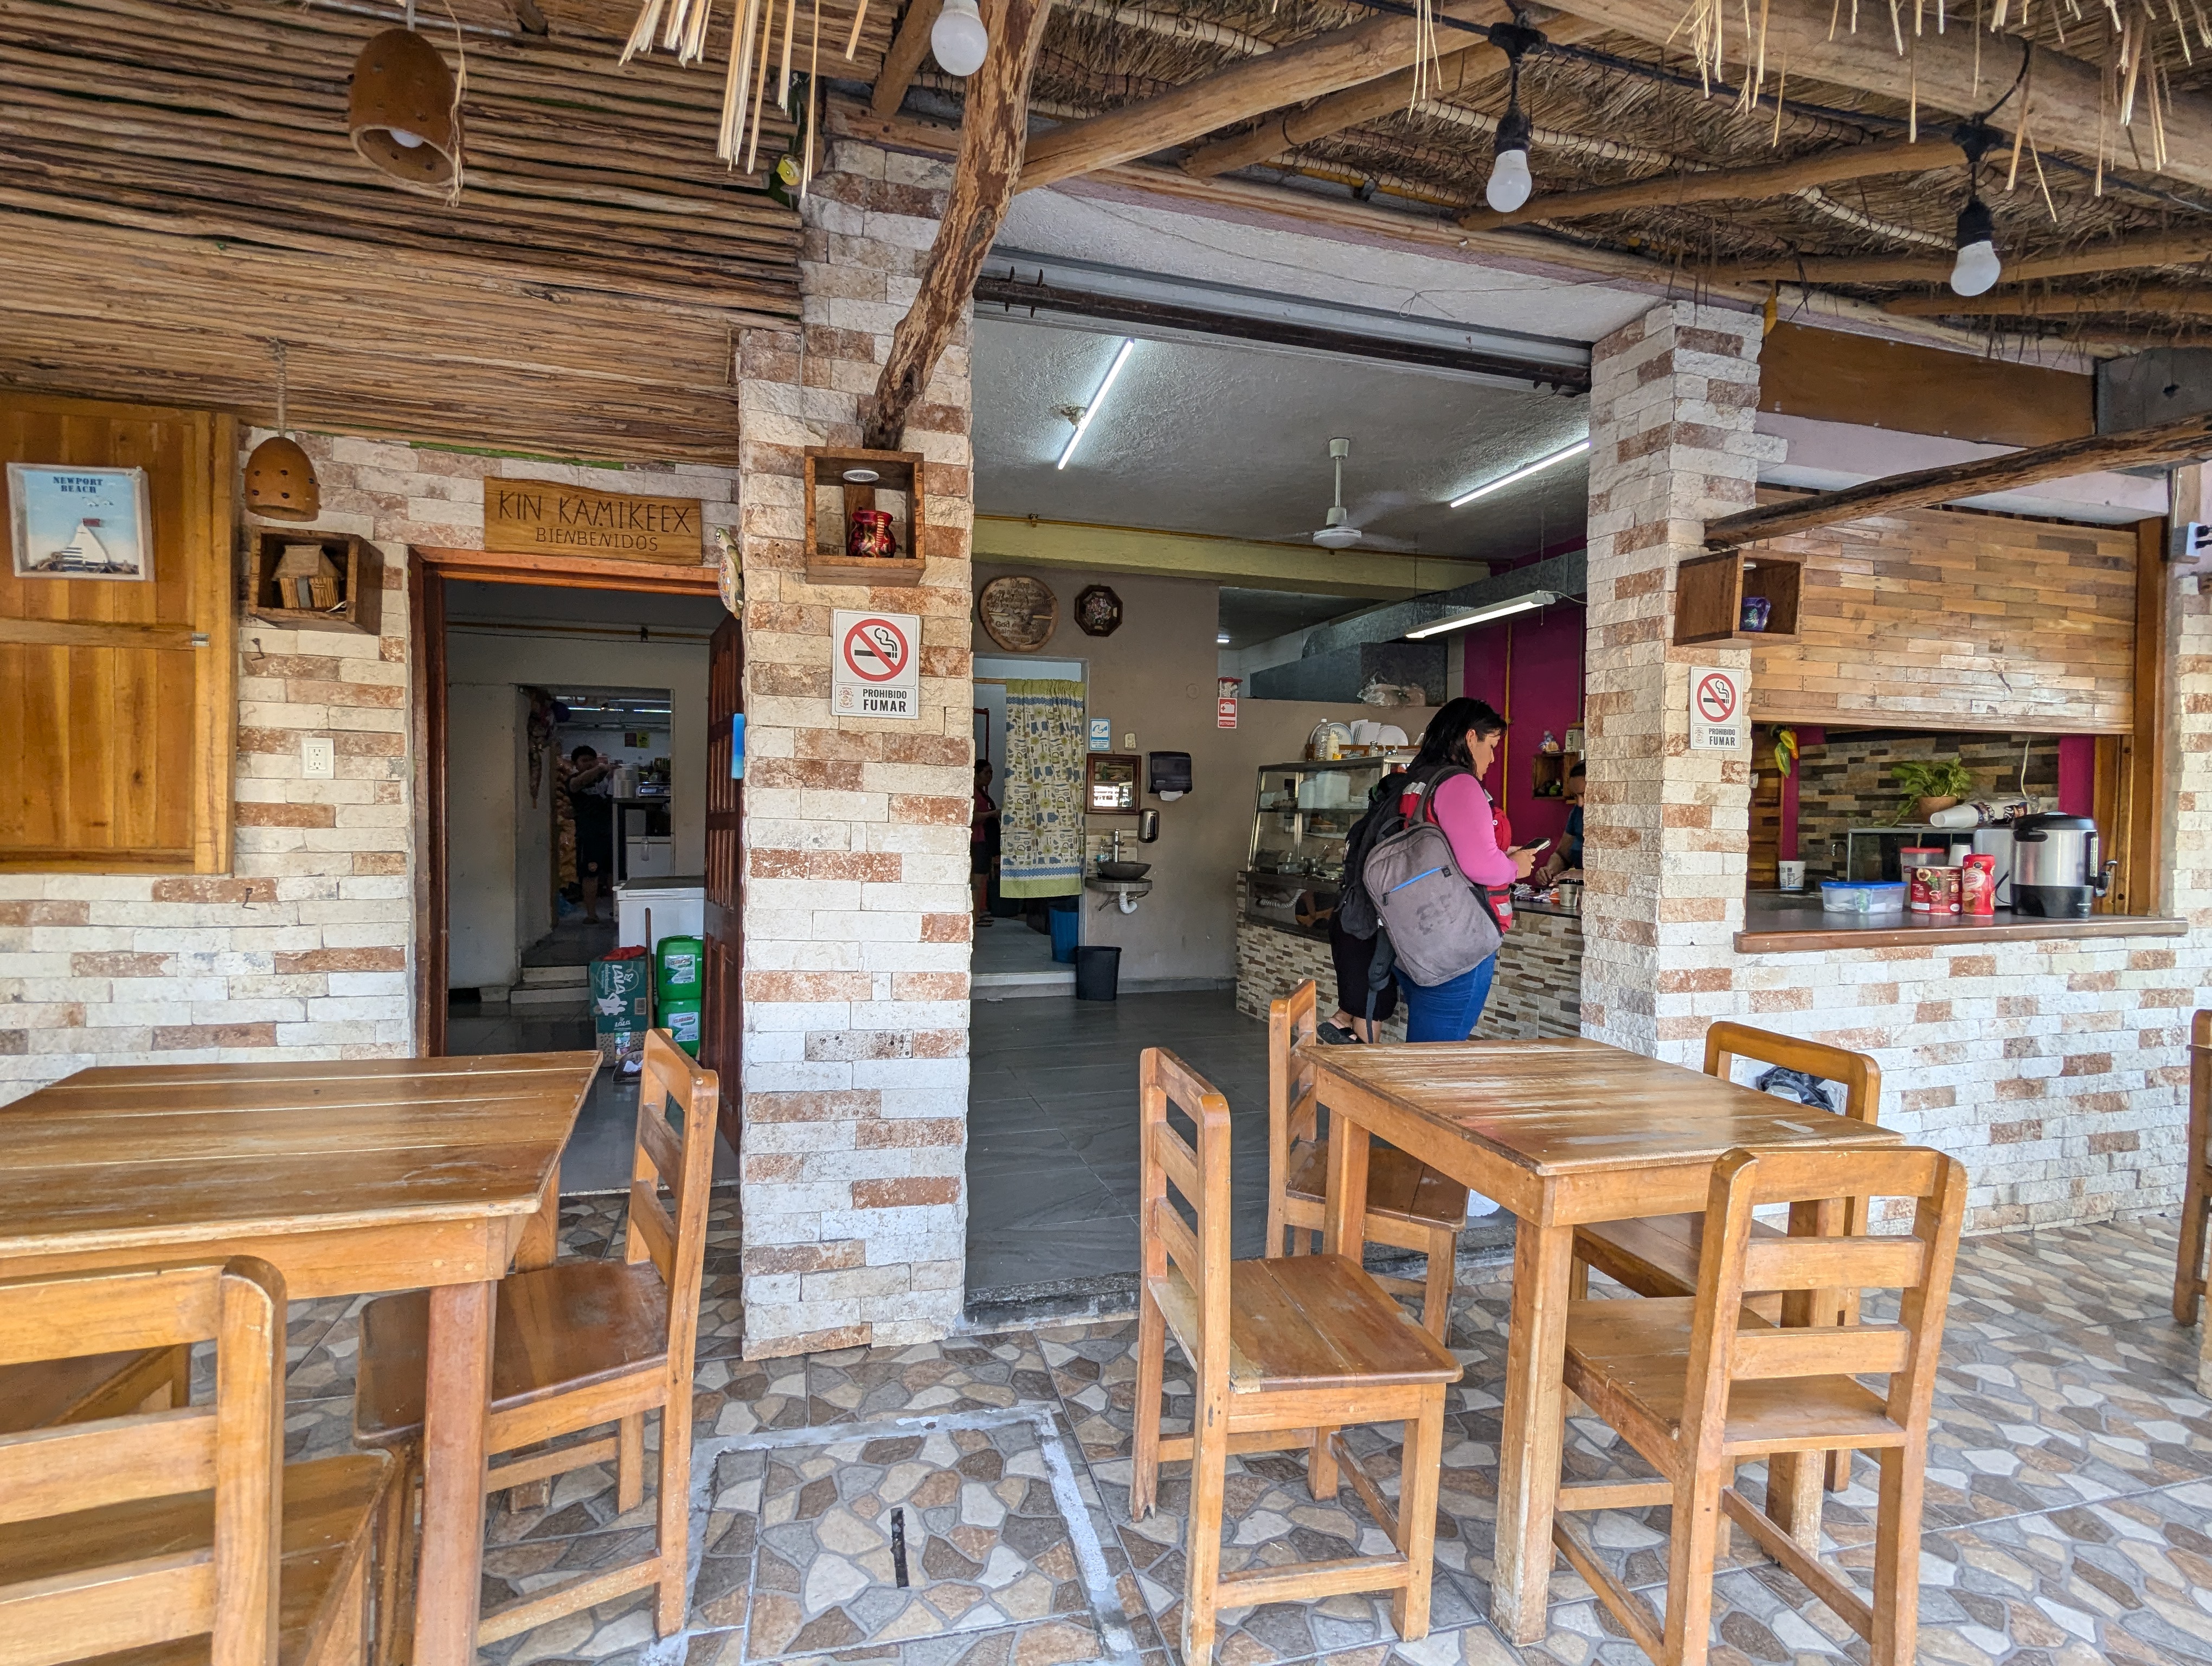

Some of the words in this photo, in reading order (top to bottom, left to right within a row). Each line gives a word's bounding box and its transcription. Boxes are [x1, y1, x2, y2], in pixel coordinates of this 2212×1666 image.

[53, 476, 103, 485] NEWPORT
[61, 485, 97, 493] BEACH
[499, 490, 542, 521] KIN
[559, 496, 691, 533] KAMIKEEX
[536, 527, 658, 551] BIENBENIDOS
[863, 689, 907, 699] PROHIBIDO
[863, 699, 906, 712] FUMAR
[1709, 736, 1735, 746] FUMAR
